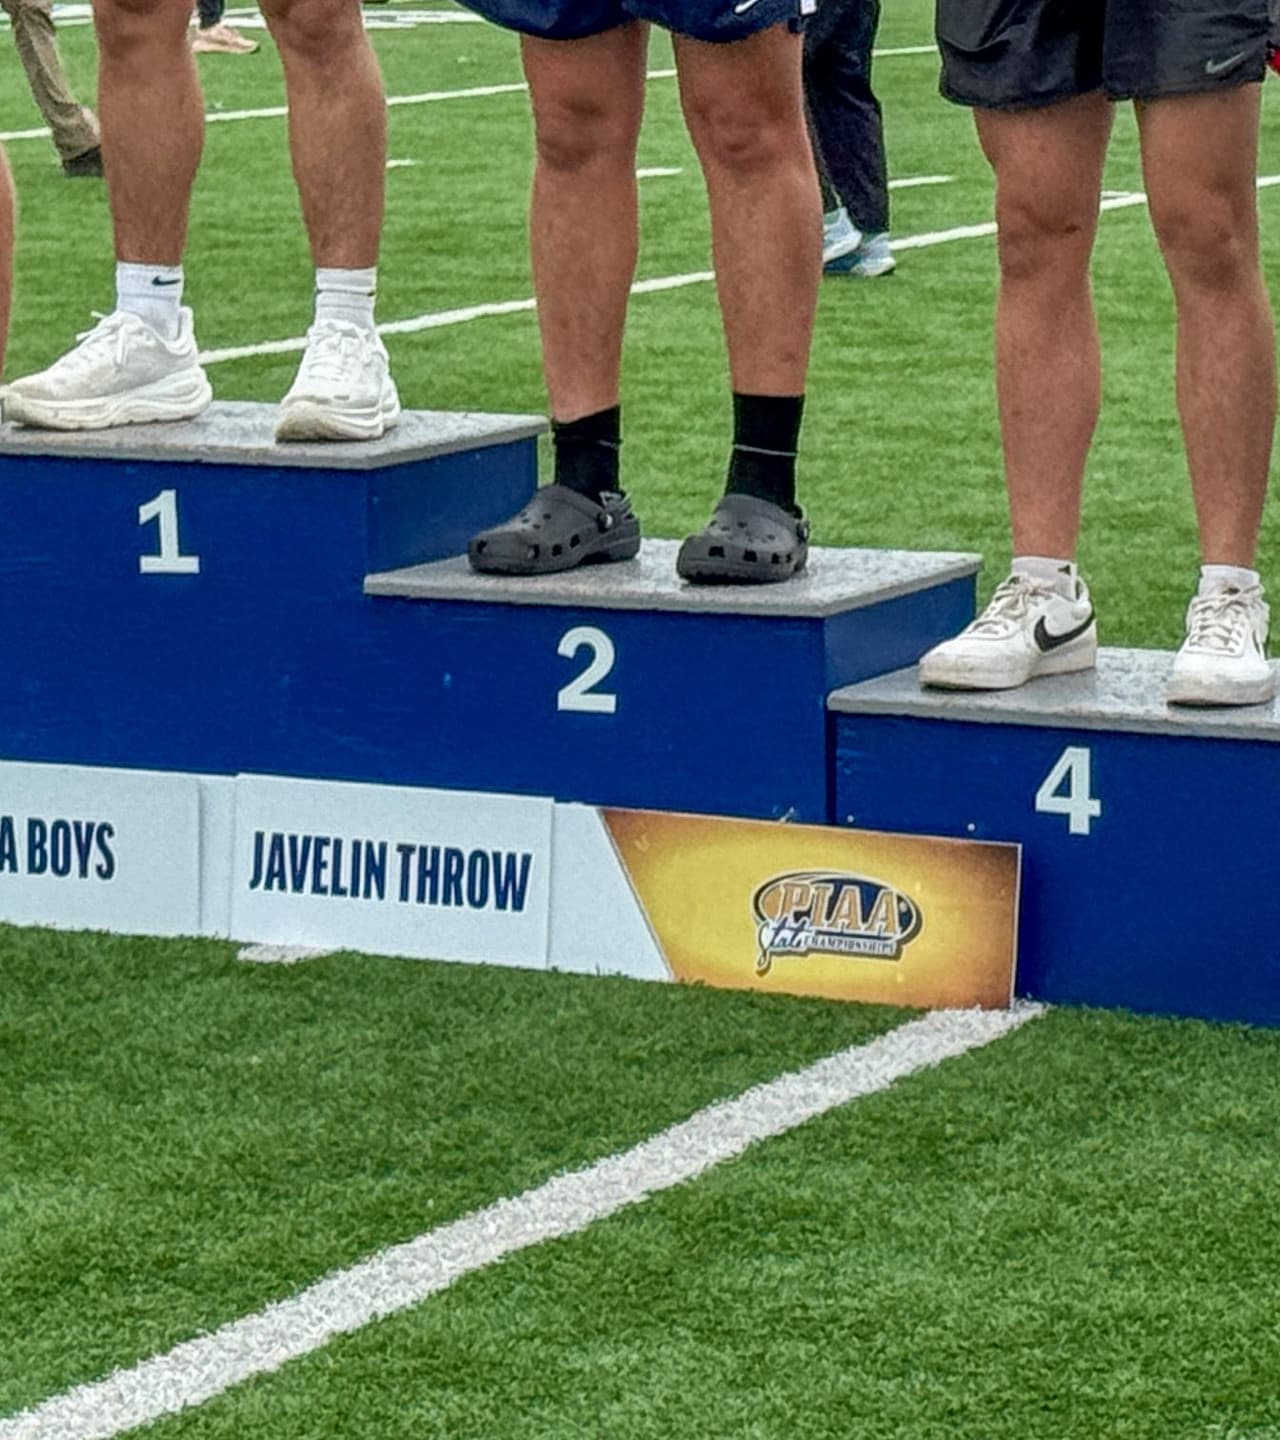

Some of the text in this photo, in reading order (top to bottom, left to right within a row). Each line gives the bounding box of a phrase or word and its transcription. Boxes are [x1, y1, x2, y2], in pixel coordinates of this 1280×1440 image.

[139, 490, 199, 574] 1
[557, 626, 617, 713] 2
[1035, 747, 1101, 835] 4
[27, 817, 115, 880] BOYS
[249, 831, 533, 912] JAVELIN THROW
[779, 881, 901, 936] PIAA
